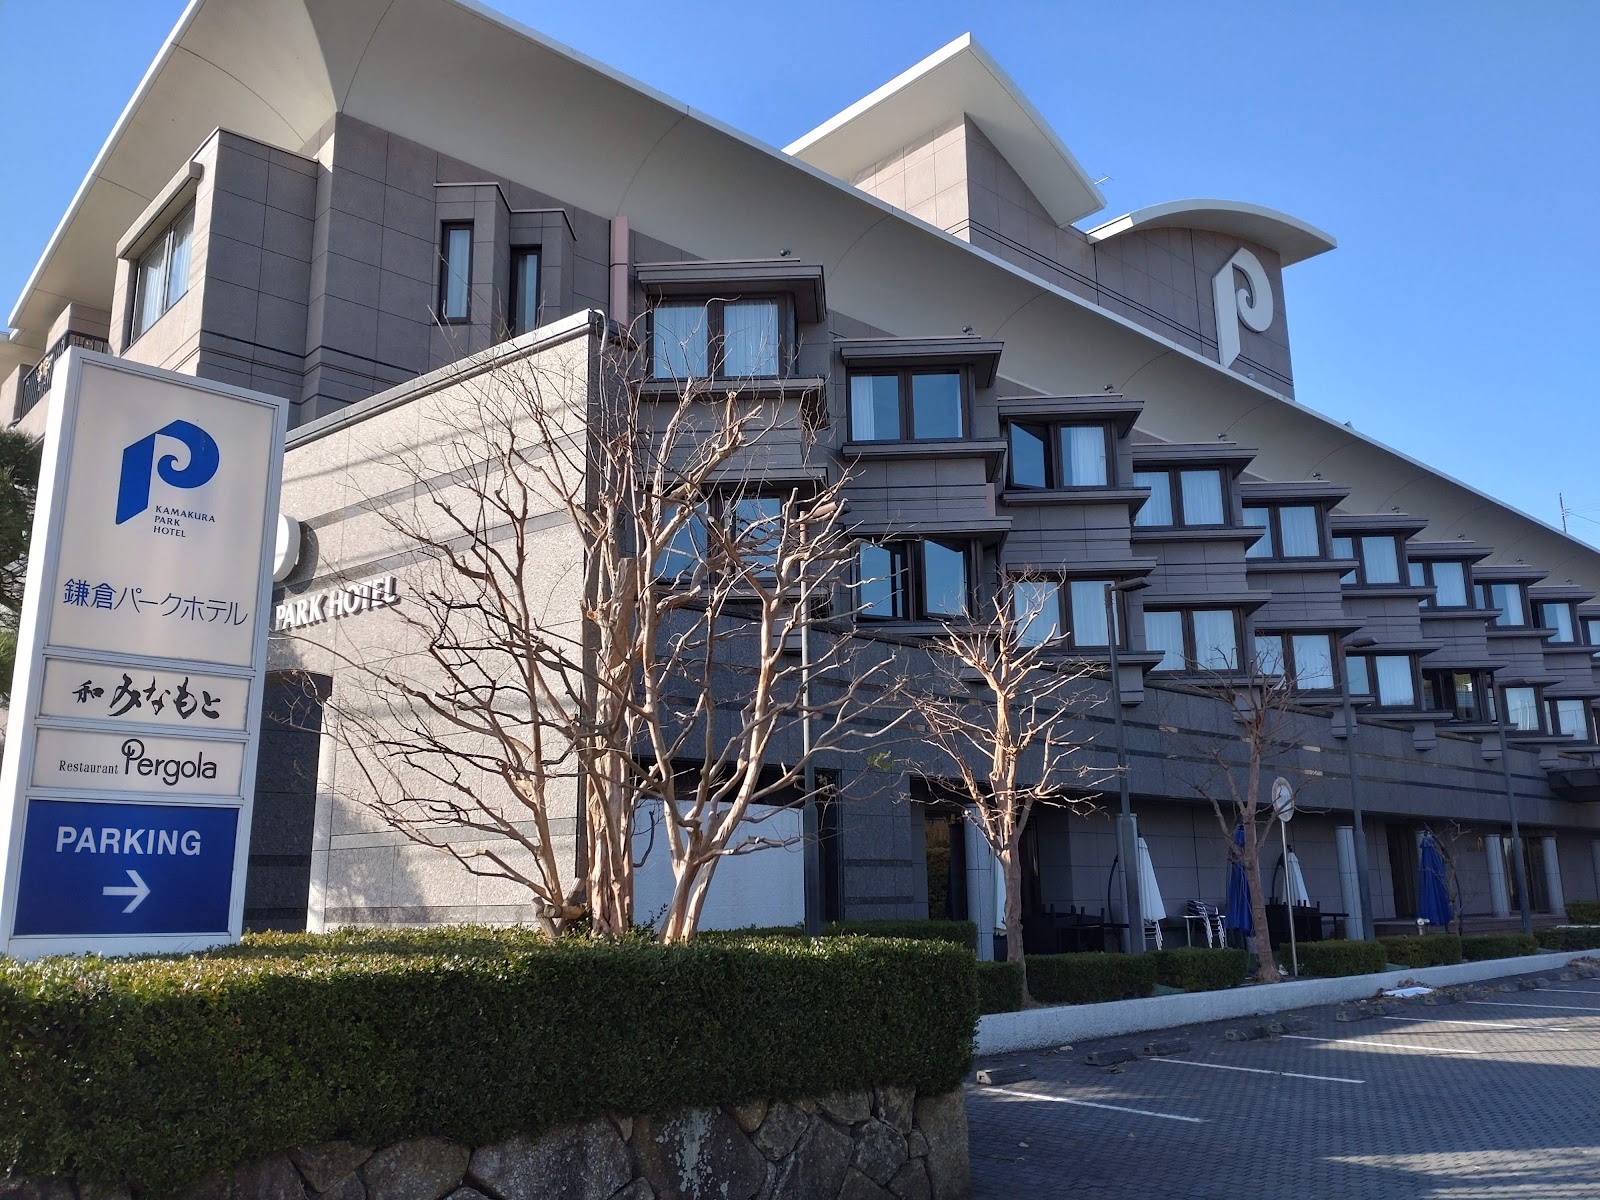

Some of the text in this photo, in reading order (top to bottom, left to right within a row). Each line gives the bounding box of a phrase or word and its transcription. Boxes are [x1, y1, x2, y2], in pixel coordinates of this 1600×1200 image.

[153, 525, 187, 538] HOTEL
[154, 515, 181, 527] PARK
[155, 505, 216, 523] KAMAKURA
[62, 578, 249, 626] 鎌倉パークホテル
[274, 575, 400, 631] PARK HOTEL
[72, 673, 221, 720] 和 みなもと
[58, 738, 218, 786] Restaurant Pergola
[55, 826, 202, 856] PARKING
